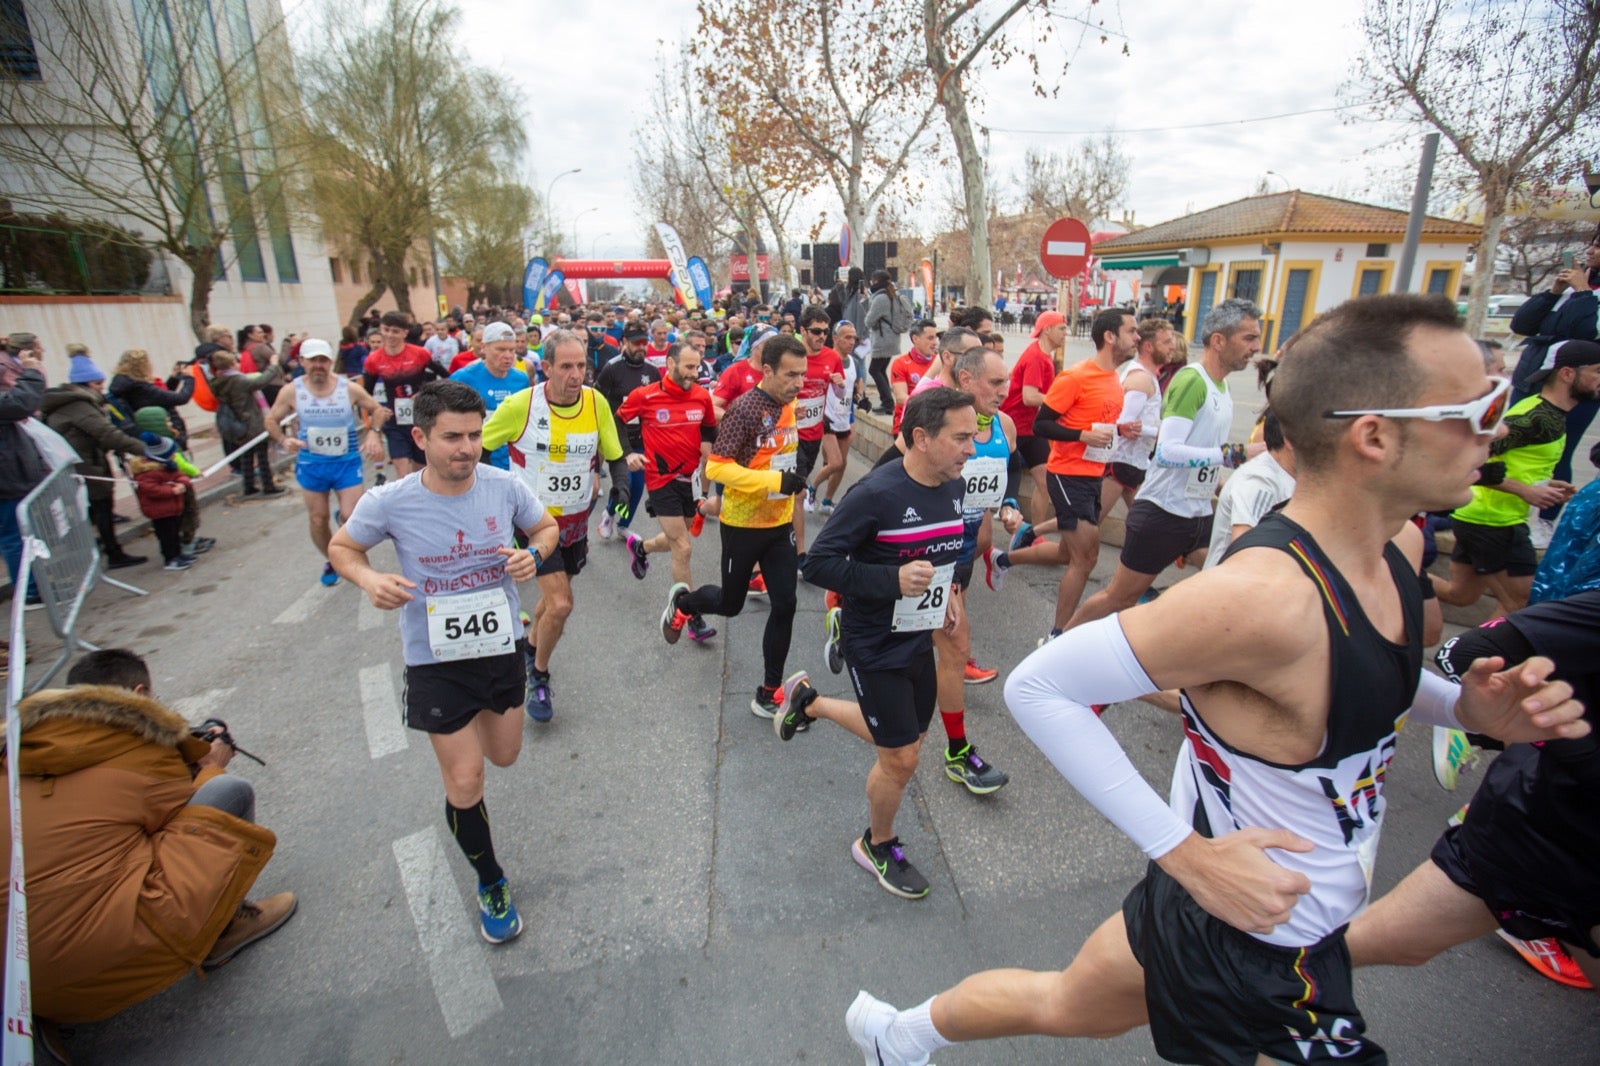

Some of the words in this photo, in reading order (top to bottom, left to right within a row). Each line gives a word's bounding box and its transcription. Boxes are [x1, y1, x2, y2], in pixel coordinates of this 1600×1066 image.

[398, 408, 412, 417] 30
[315, 436, 342, 447] 619
[548, 475, 582, 492] 393
[966, 475, 999, 494] 664
[450, 544, 473, 553] XXVI
[418, 554, 455, 564] PRUEBA
[458, 551, 470, 559] DE
[916, 586, 944, 611] 28
[444, 610, 499, 640] 546
